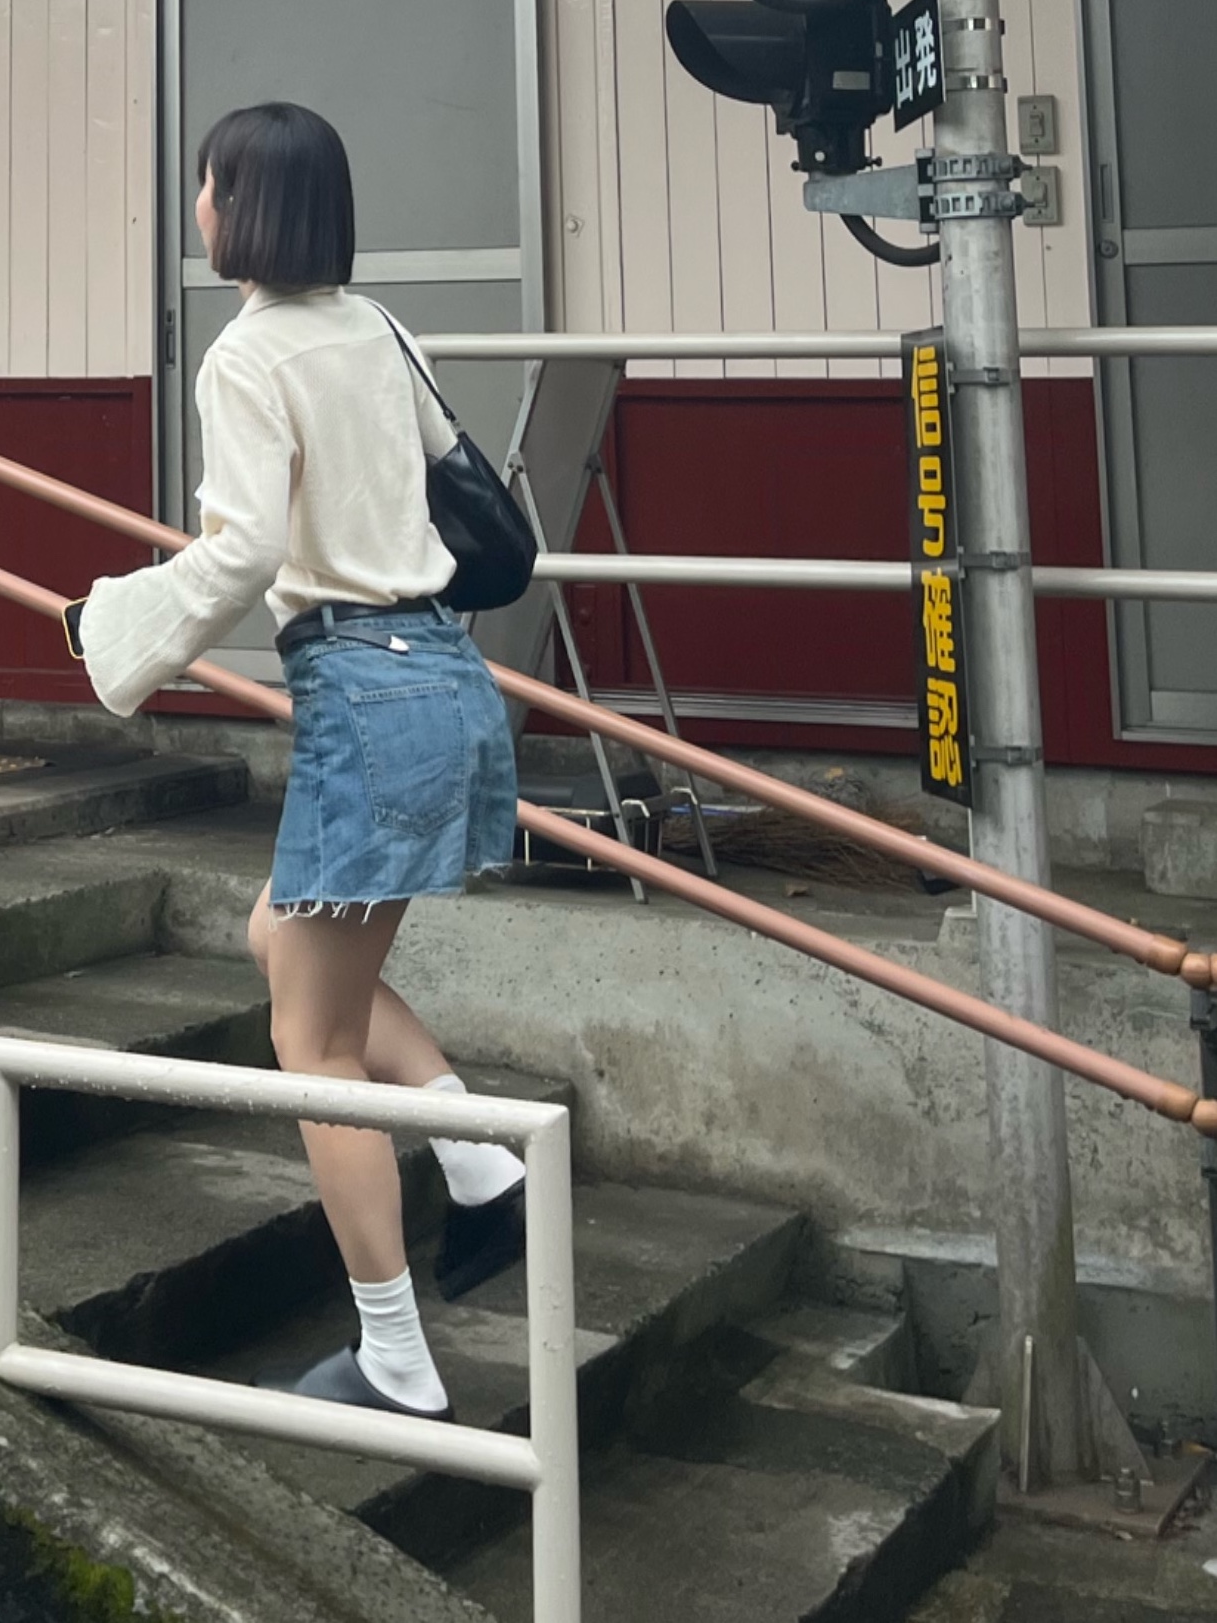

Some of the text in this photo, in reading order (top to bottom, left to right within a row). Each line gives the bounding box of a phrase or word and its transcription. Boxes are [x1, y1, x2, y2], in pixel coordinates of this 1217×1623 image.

[894, 8, 938, 110] 出発
[911, 344, 963, 788] 信号確認
